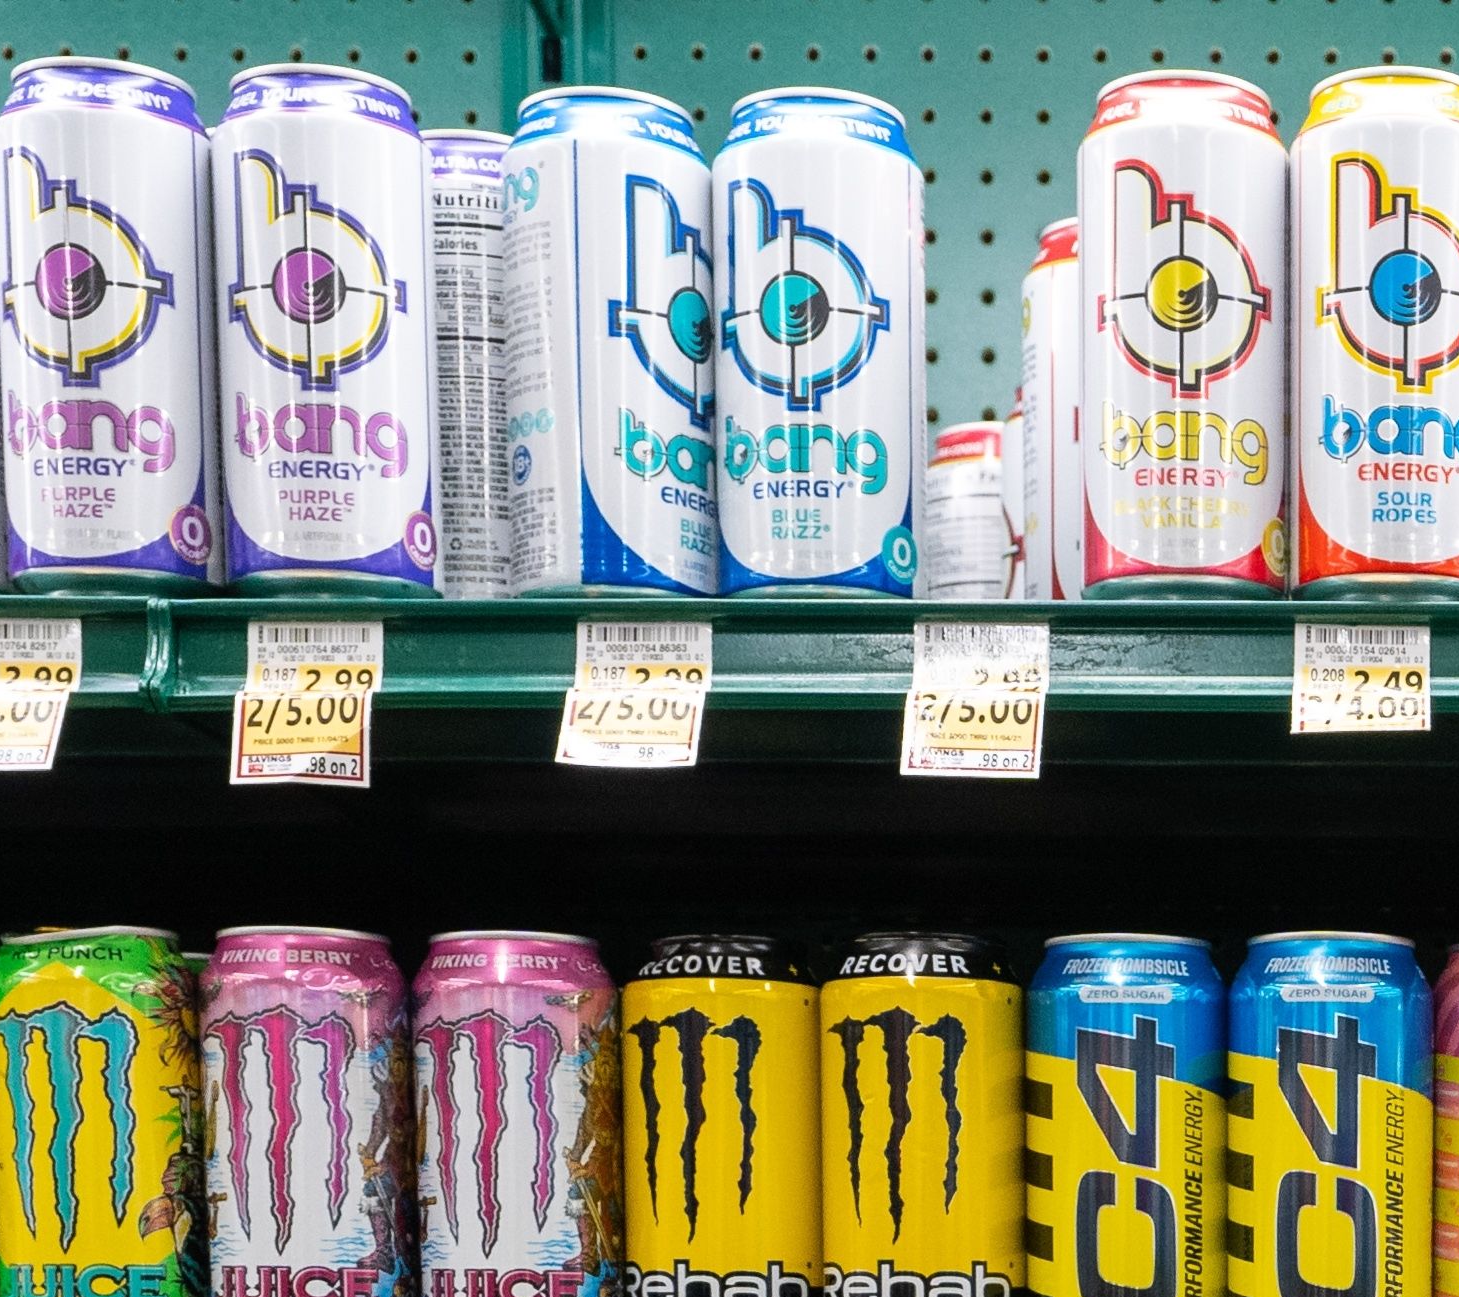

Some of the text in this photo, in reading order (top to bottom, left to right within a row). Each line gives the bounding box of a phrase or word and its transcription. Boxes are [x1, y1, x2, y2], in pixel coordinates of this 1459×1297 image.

[236, 392, 407, 480] bang
[725, 416, 888, 494] bang
[269, 461, 364, 480] ENERGY
[1377, 491, 1432, 508] SOUR
[772, 509, 821, 525] BLUE
[1372, 508, 1438, 525] ROPES
[262, 668, 297, 682] 0.187
[248, 695, 359, 728] 2/5.00
[221, 950, 352, 965] VIKING BERRY
[639, 954, 764, 977] RECOVER
[1062, 956, 1108, 974] FROZEN
[1178, 1087, 1202, 1168] ENERGY
